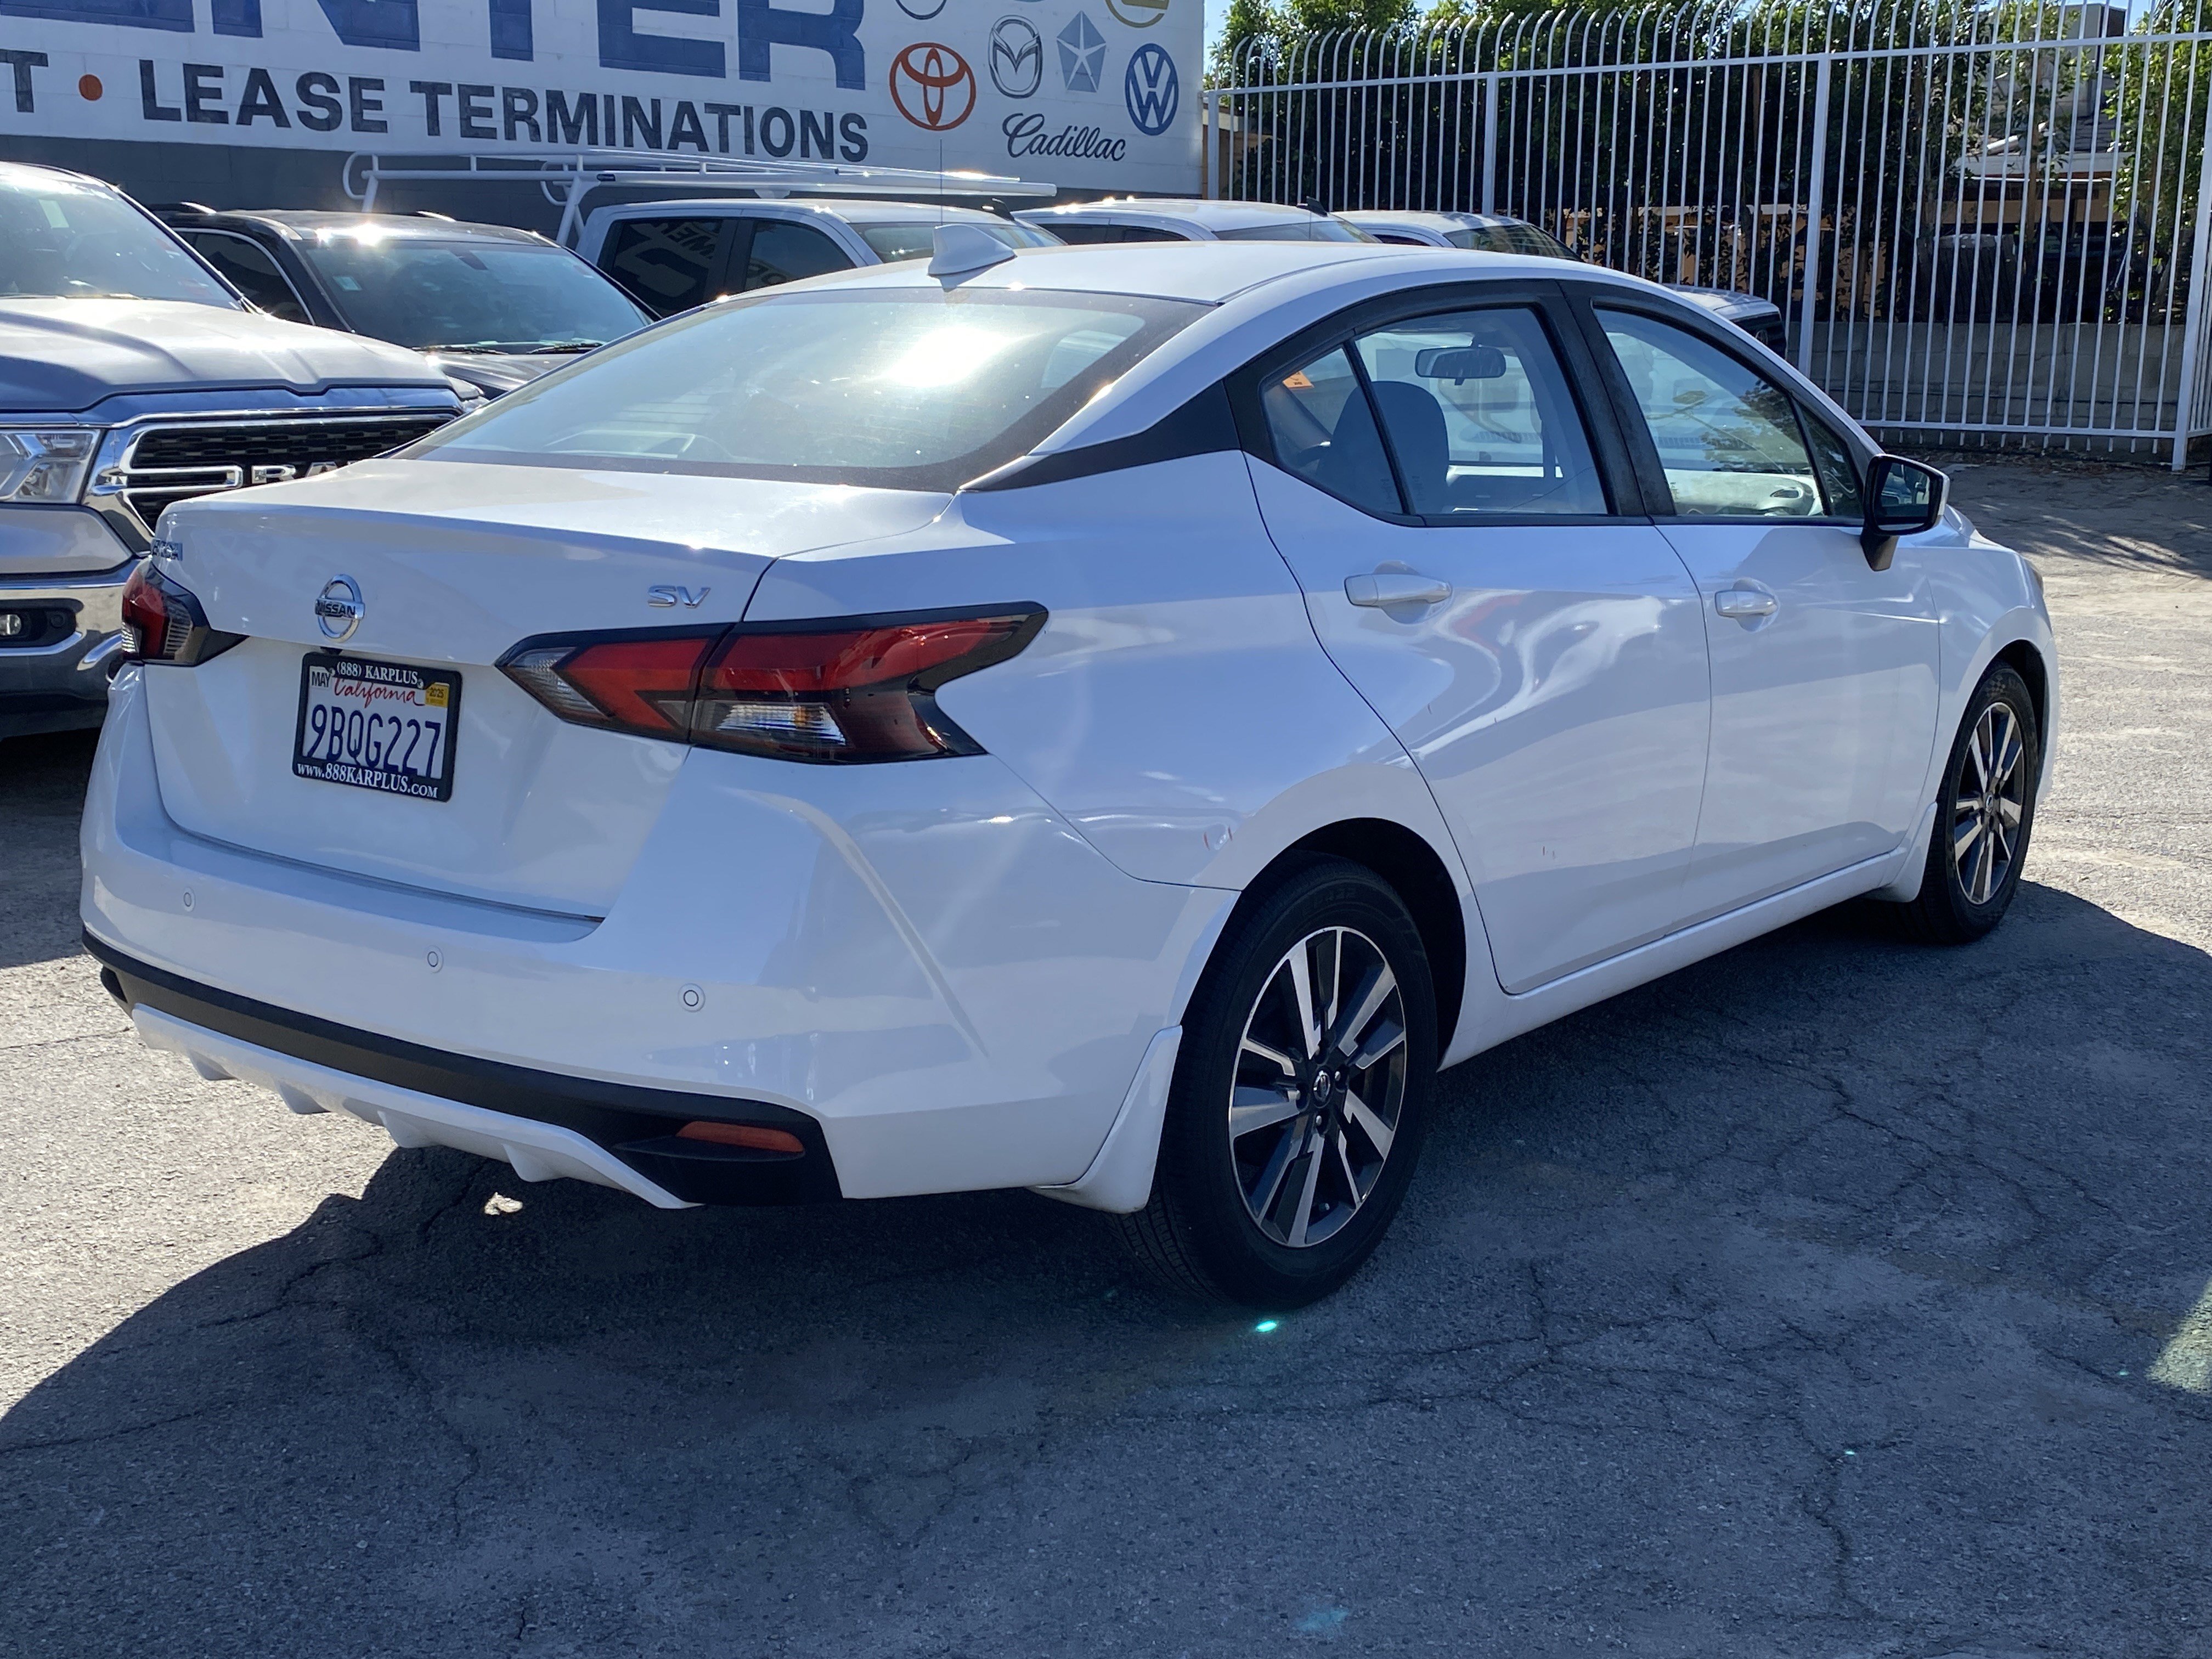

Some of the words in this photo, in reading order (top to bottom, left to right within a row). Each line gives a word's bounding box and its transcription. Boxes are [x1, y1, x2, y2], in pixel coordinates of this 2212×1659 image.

[139, 59, 388, 133] LEASE
[409, 81, 868, 162] TERMINATIONS
[1002, 112, 1126, 162] Cadillac
[315, 600, 356, 617] NISSAN
[647, 585, 711, 608] SV
[312, 672, 330, 687] MAY
[337, 662, 362, 677] (888)
[365, 665, 418, 685] KARPLUS
[334, 678, 425, 708] California
[307, 704, 441, 778] 9BQG227
